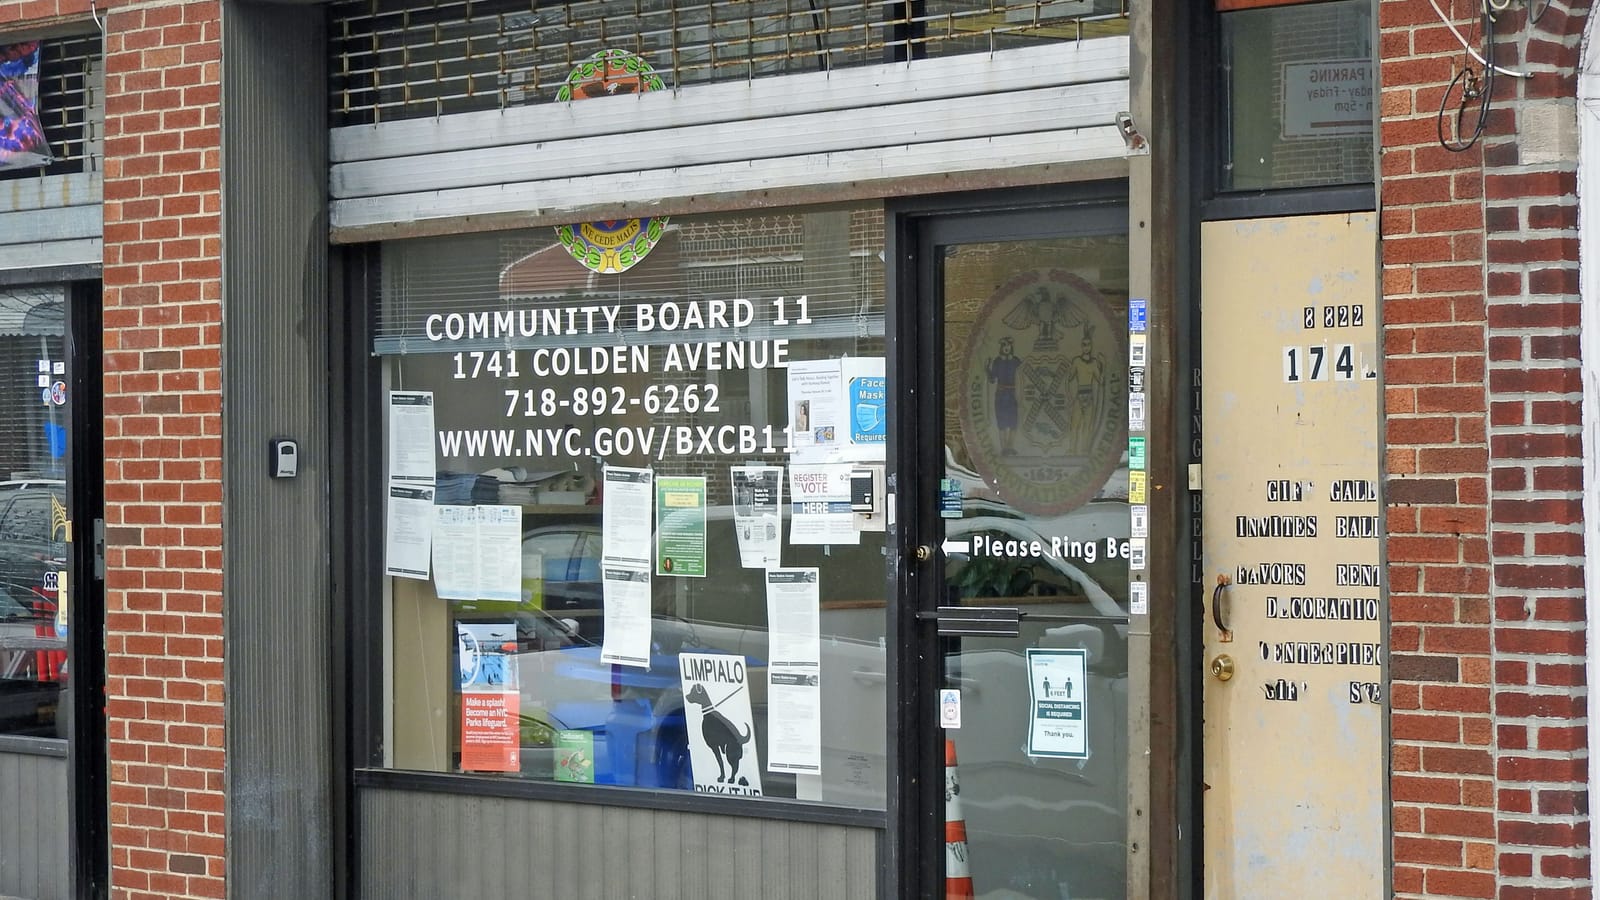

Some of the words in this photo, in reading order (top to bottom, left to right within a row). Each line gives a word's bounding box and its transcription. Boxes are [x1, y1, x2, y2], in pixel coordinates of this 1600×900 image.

[583, 224, 595, 240] NE
[594, 233, 616, 246] CEDE
[616, 223, 638, 243] MALIS
[426, 304, 621, 341] COMMUNITY
[637, 298, 755, 332] BOARD
[773, 296, 812, 326] 11
[454, 350, 520, 379] 1741
[533, 345, 649, 377] COLDEN
[663, 340, 789, 372] AVENUE
[1286, 346, 1376, 381] 174
[861, 378, 886, 388] Face
[505, 384, 720, 417] 718-892-6262
[439, 424, 796, 460] WWW.NYC.GOV/BXCB11
[794, 473, 828, 482] REGISTER
[801, 482, 828, 493] VOTE
[802, 502, 829, 514] HERE
[1237, 516, 1317, 538] INVITES
[973, 535, 1042, 557] Please
[1051, 535, 1097, 564] Ring
[1237, 563, 1306, 586] FAVORS
[683, 658, 745, 684] LIMPIALO
[465, 697, 482, 707] Make
[465, 708, 489, 717] Become
[489, 710, 496, 718] an
[496, 708, 509, 718] NYC
[465, 718, 482, 728] Parks
[1062, 731, 1074, 739] you.
